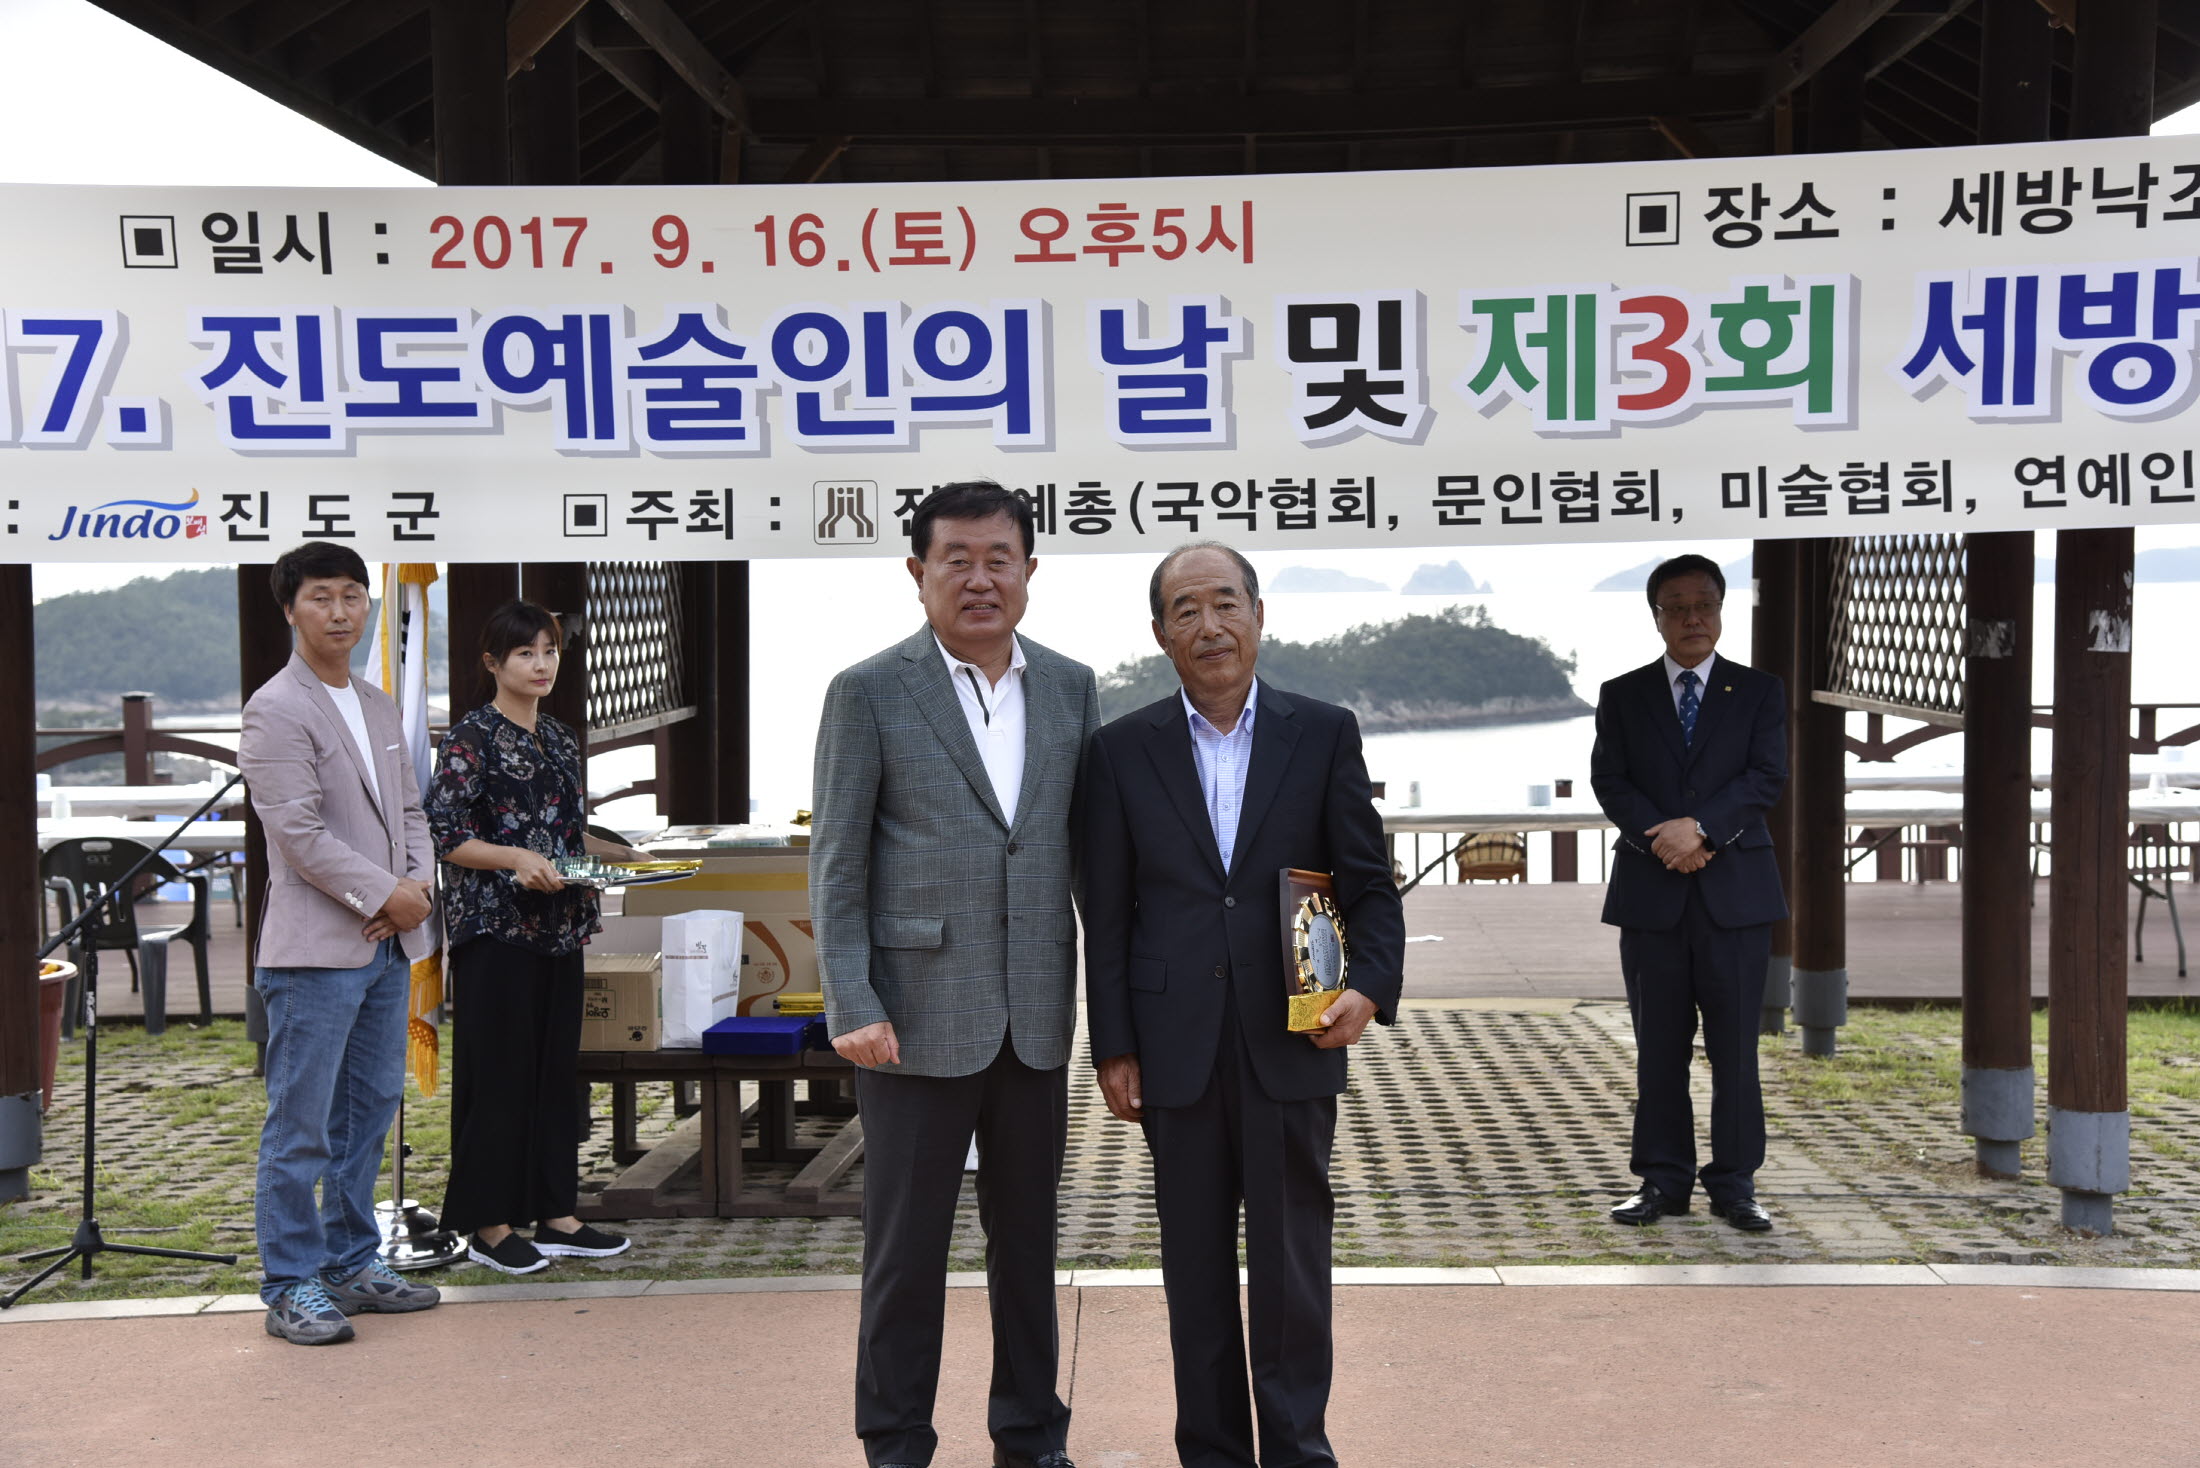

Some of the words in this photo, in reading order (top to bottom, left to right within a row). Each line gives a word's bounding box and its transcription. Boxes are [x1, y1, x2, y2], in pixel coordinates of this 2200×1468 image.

[202, 211, 332, 275] 일시
[374, 222, 389, 265] :
[429, 215, 613, 274] 2017.
[651, 214, 714, 273] 9.
[1014, 200, 1254, 267] 오후5시
[1703, 182, 1840, 249] 장소
[1881, 187, 1896, 231] :
[200, 309, 1031, 441] 진도예술인의
[1100, 305, 1229, 434] 날
[1288, 299, 1408, 430] 및
[1467, 284, 1835, 421] 제3회
[1902, 267, 2200, 406] 세방
[48, 506, 180, 541] Jindo
[626, 488, 734, 541] 주최
[770, 496, 781, 531] :
[893, 476, 1399, 538] 예총(국악협회,
[1432, 469, 1683, 526] 문인협회,
[1721, 459, 1976, 519] 미술협회,
[2014, 449, 2196, 509] 연예인
